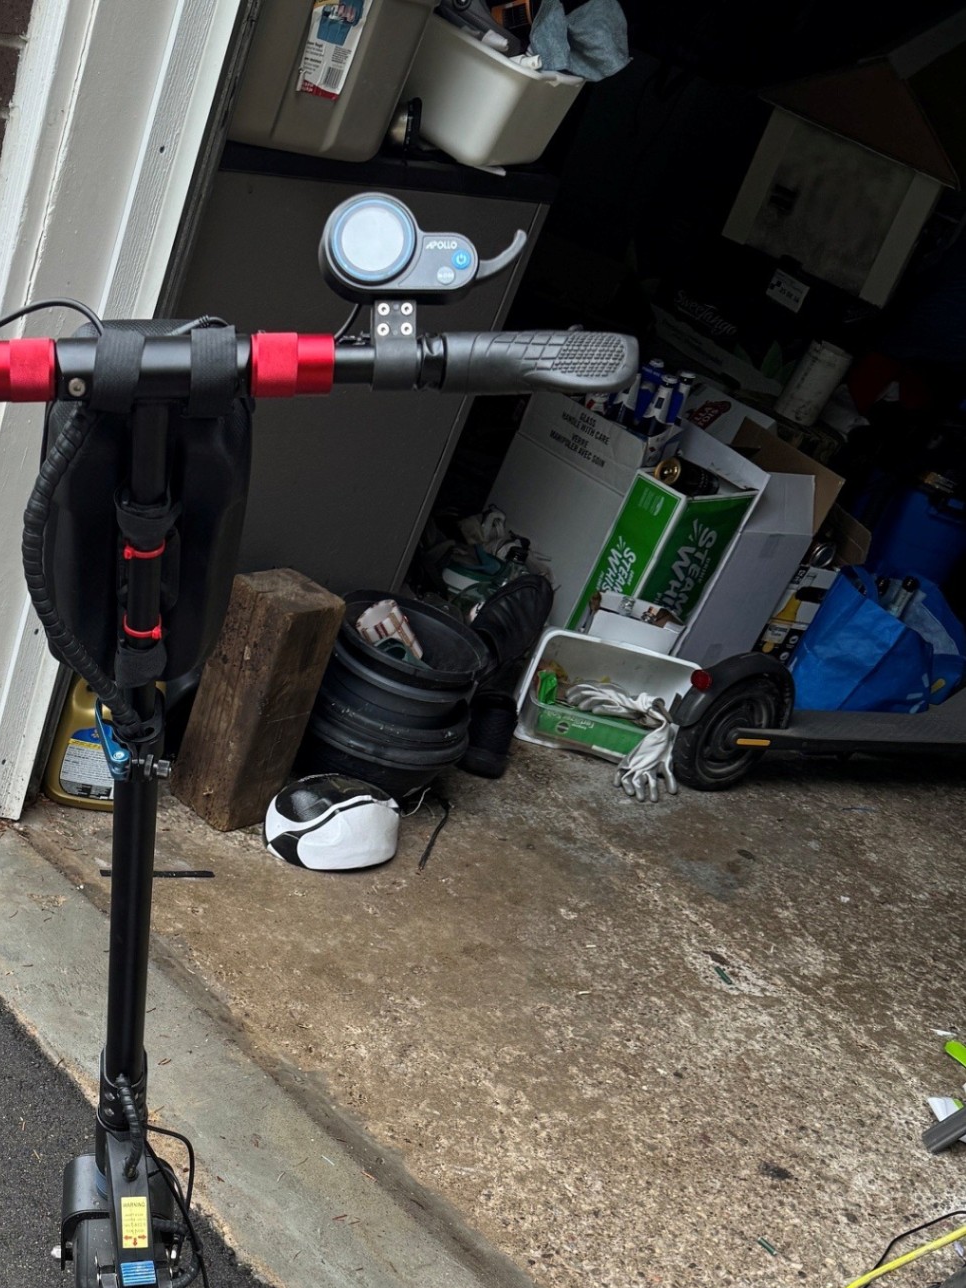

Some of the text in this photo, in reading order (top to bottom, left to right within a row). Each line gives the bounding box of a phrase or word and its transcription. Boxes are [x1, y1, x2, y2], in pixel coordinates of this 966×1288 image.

[425, 240, 458, 250] APOLLO
[561, 411, 610, 445] HANDLE WITH CARE
[579, 412, 597, 427] GLASS
[601, 548, 622, 592] WHIS
[612, 546, 637, 593] STEAM
[674, 529, 718, 617] STEAM
